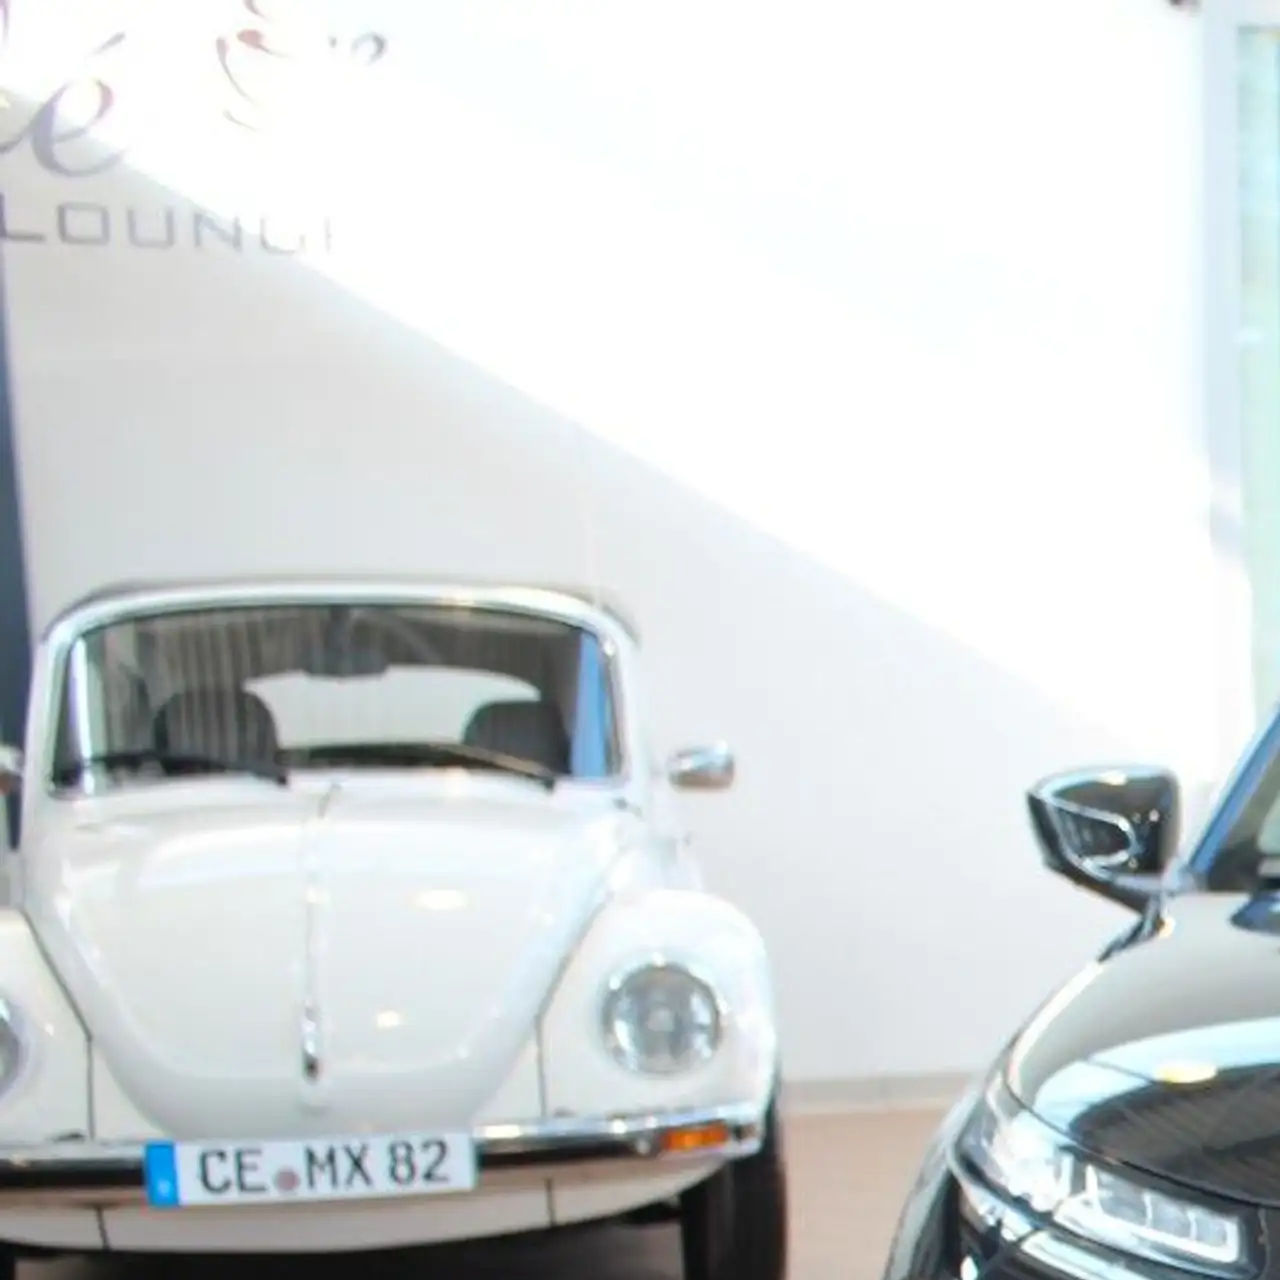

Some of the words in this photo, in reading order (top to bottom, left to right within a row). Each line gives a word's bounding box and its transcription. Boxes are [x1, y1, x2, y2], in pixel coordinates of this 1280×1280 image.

[199, 1147, 267, 1194] CE
[305, 1144, 373, 1189] MX
[387, 1138, 450, 1186] 82
